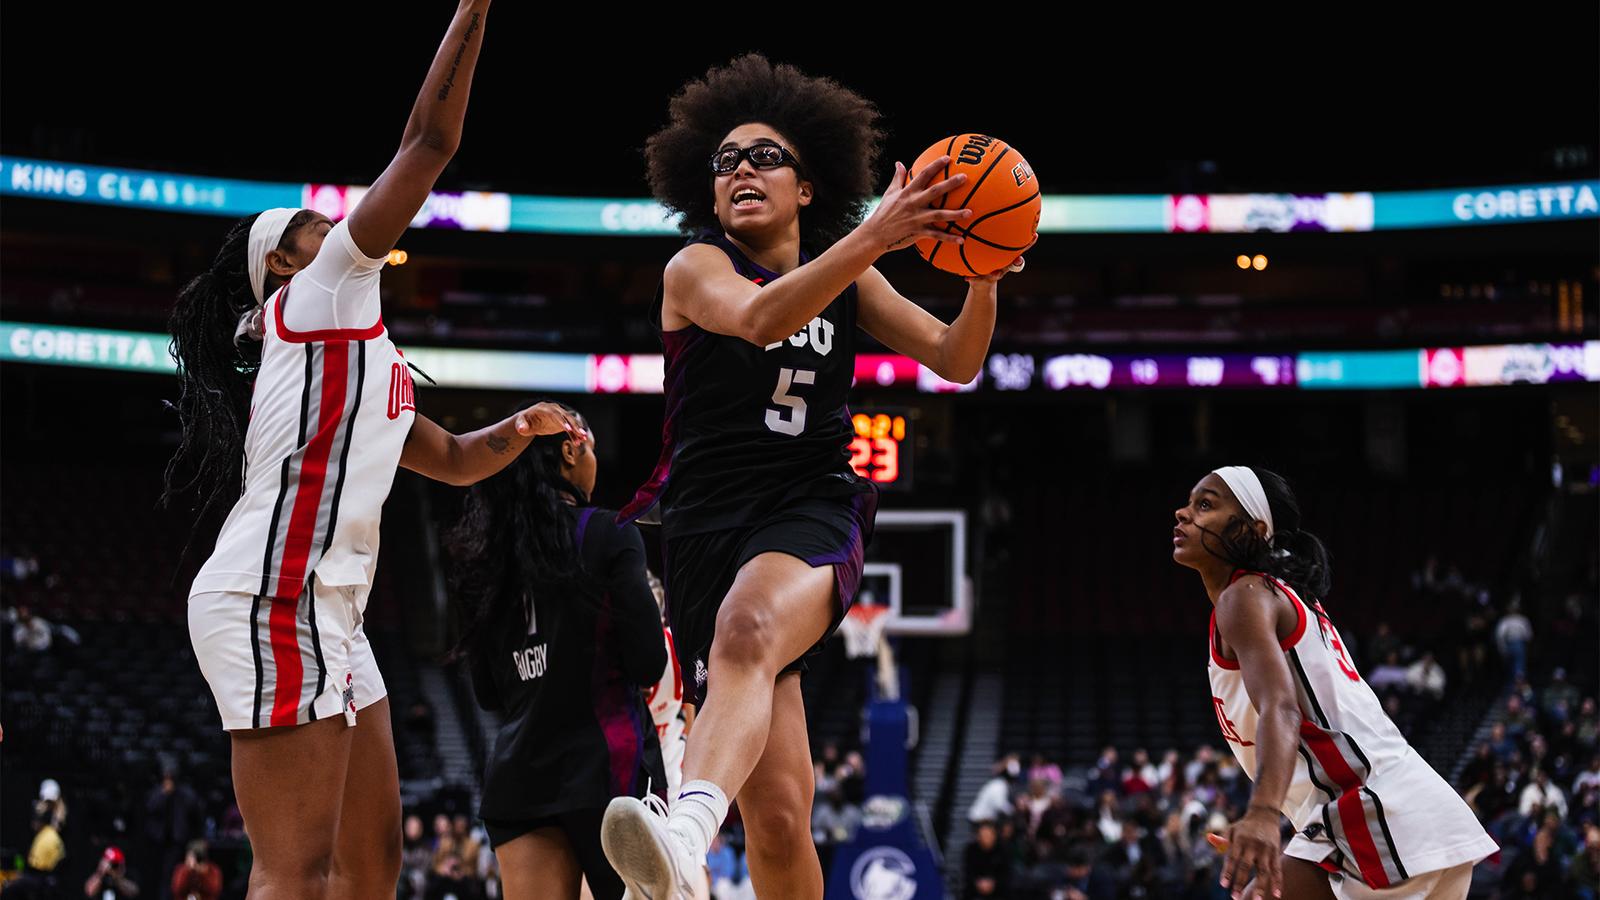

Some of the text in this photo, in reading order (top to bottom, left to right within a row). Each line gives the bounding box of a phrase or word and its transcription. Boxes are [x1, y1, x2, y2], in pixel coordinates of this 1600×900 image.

[12, 163, 86, 197] KING
[1453, 185, 1598, 221] CORETTA
[10, 328, 154, 367] CORETTA
[765, 316, 834, 356] CU
[765, 367, 816, 437] 5
